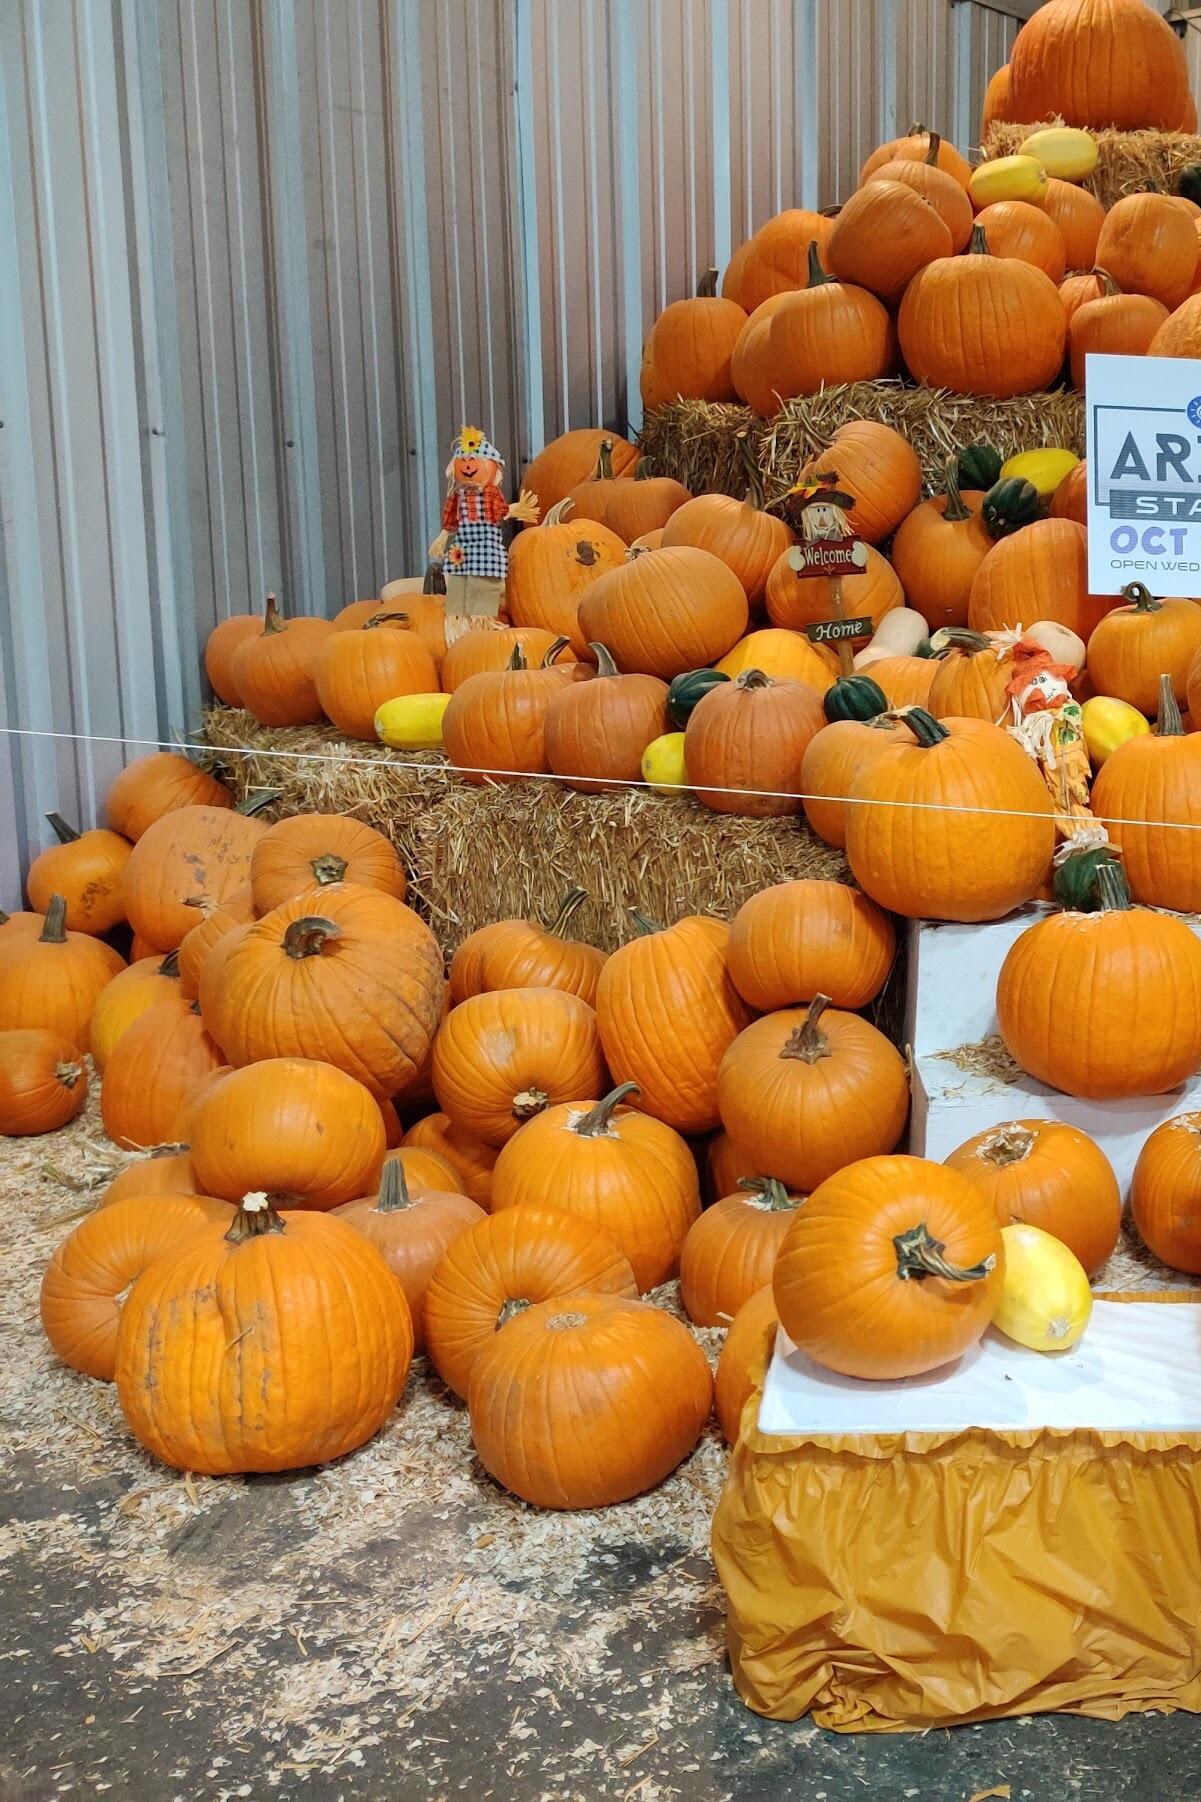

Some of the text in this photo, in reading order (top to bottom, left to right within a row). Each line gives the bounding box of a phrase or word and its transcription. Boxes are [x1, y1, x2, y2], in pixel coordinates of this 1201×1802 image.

[1109, 525, 1188, 556] OCT
[804, 547, 852, 566] Welcome
[1110, 559, 1158, 571] OPEN
[815, 622, 863, 641] Home
